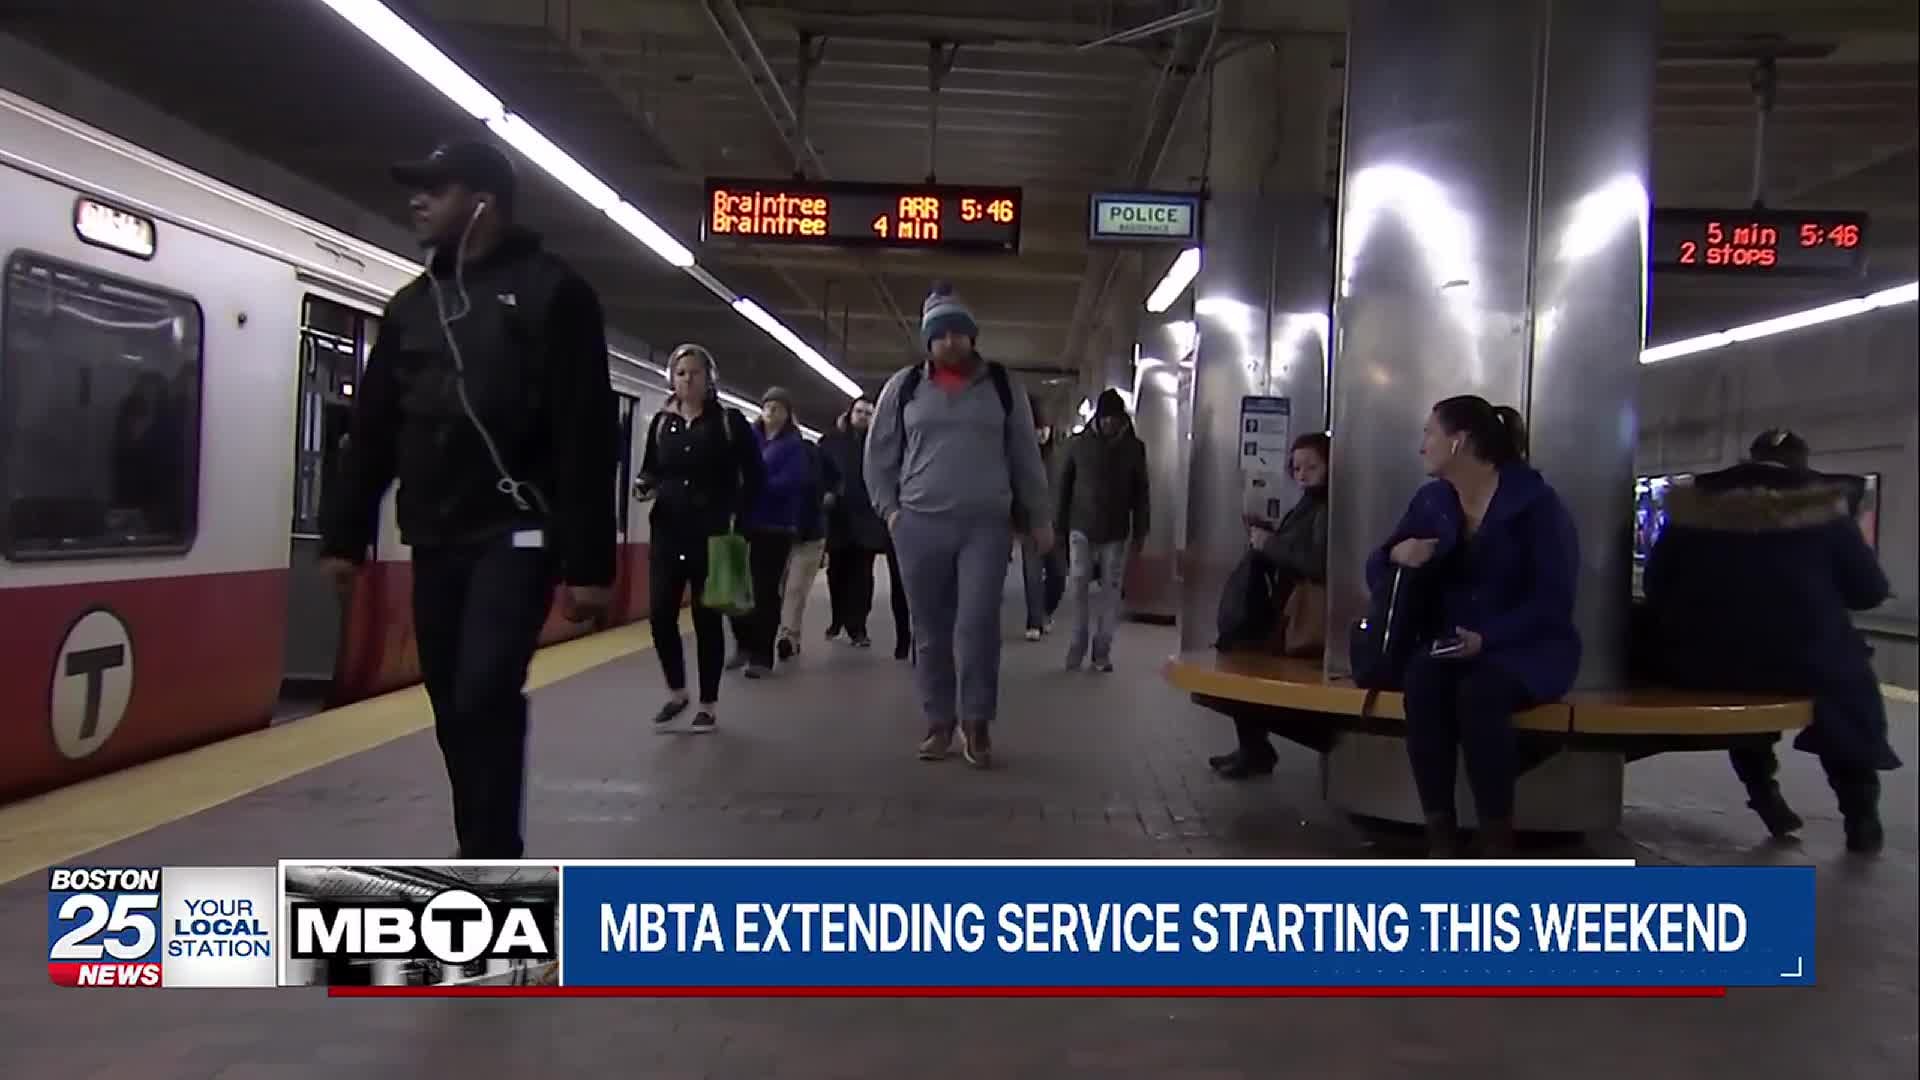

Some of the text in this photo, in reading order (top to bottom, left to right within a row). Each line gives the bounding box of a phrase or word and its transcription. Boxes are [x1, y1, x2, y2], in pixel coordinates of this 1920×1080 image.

[713, 190, 1014, 222] Braintree ARR 5:46
[1110, 206, 1178, 223] POLICE
[712, 211, 938, 240] Braintree 4 min
[1707, 222, 1860, 247] 5 min 5:46
[1680, 242, 1776, 266] 2 stops
[65, 643, 125, 740] T
